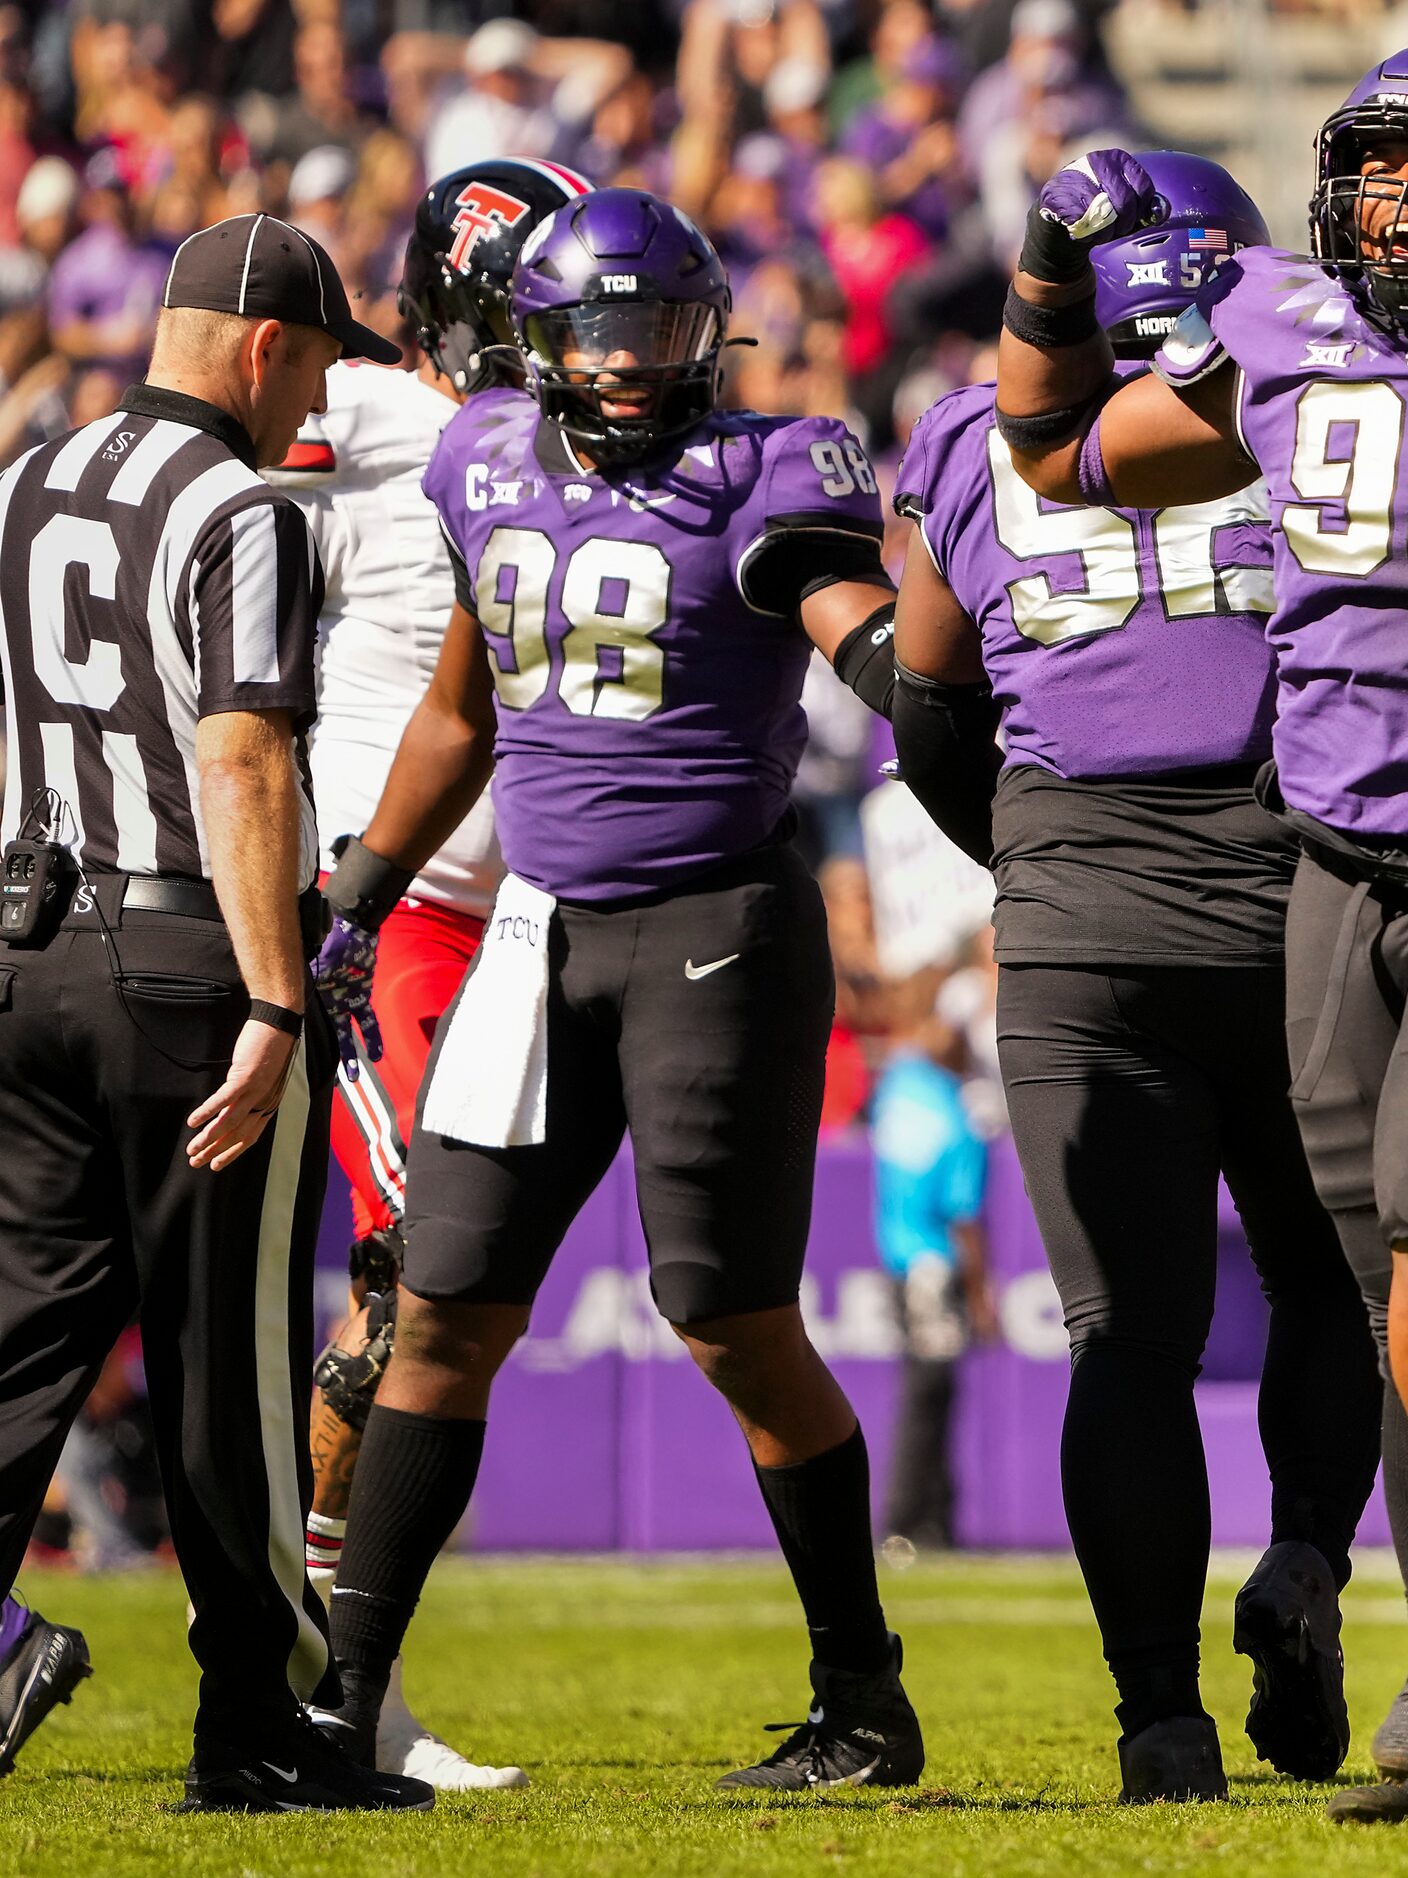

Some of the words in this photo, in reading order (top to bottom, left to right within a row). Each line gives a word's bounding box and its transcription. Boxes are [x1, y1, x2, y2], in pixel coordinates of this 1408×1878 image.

[600, 275, 637, 292] TCU
[1123, 260, 1172, 288] XII
[1298, 342, 1352, 369] XII
[466, 463, 489, 511] C
[809, 438, 878, 499] 98
[29, 513, 127, 712] C
[475, 525, 674, 723] 98
[498, 916, 539, 947] TCU
